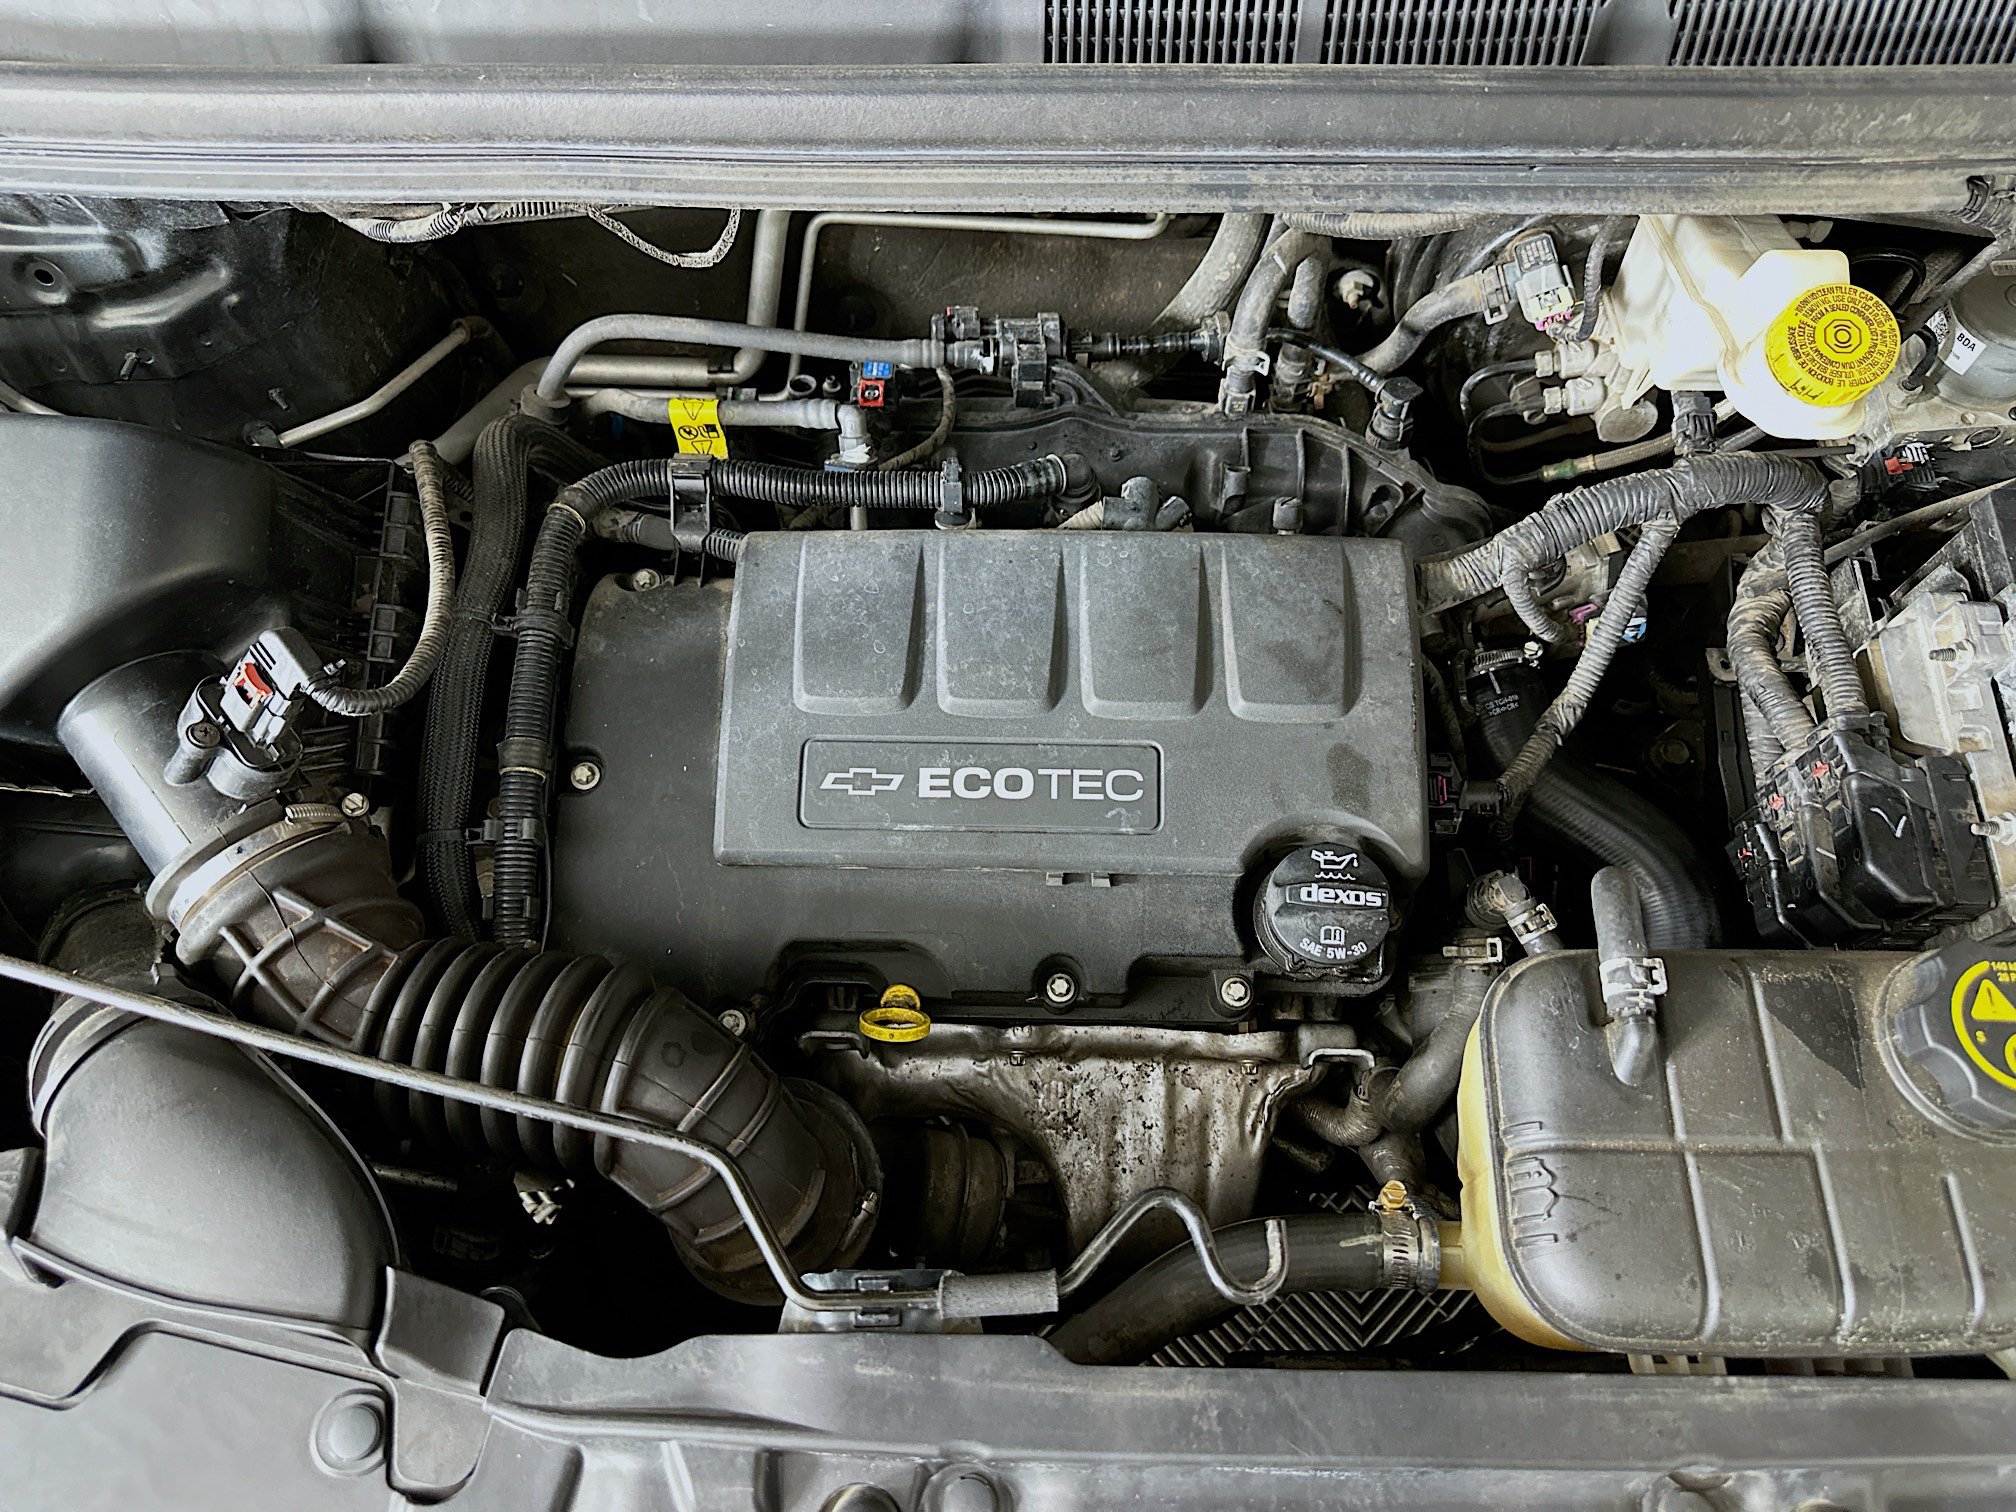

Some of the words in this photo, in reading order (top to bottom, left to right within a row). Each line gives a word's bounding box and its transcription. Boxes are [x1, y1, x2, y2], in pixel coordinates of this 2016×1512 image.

[1829, 303, 1849, 312] SEALED
[1835, 286, 1858, 296] FILLER
[1859, 292, 1873, 302] CAP
[1872, 300, 1892, 323] BEFORE
[1847, 296, 1862, 306] ONLY
[1956, 333, 1977, 352] BDA
[1798, 359, 1808, 368] DE
[918, 766, 1145, 802] ECOTEC
[1300, 883, 1383, 908] dexos
[1300, 938, 1323, 957] SAE
[1326, 941, 1368, 960] 5W-30
